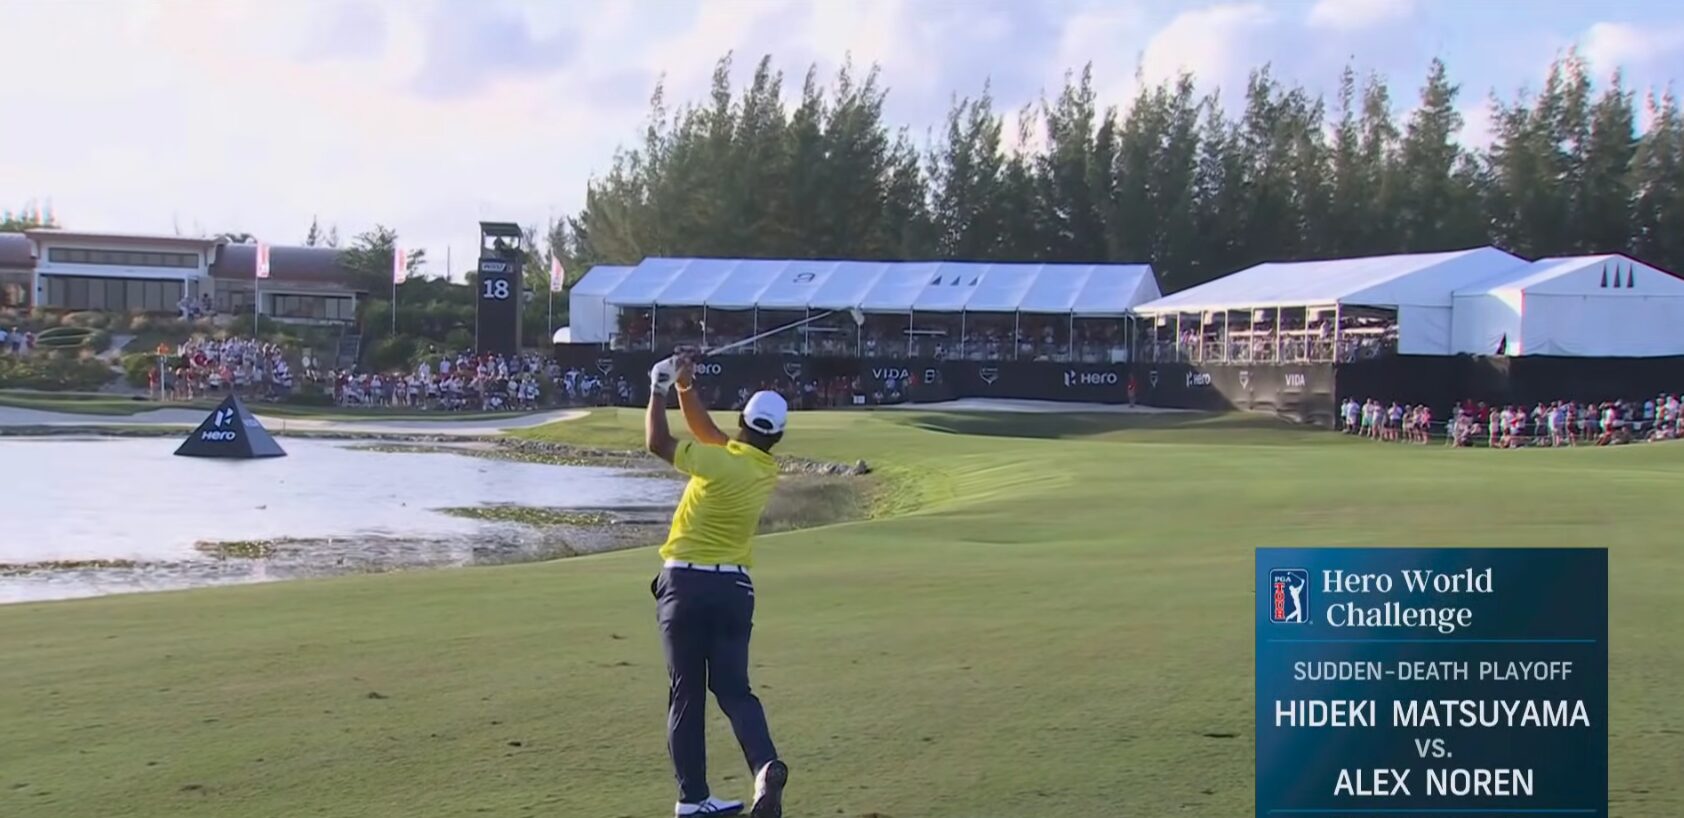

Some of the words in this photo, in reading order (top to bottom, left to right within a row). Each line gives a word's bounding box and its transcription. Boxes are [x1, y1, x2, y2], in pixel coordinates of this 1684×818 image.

[483, 280, 509, 299] 18
[694, 362, 722, 375] ero
[872, 368, 909, 379] VIDA
[1285, 373, 1306, 387] VIDA
